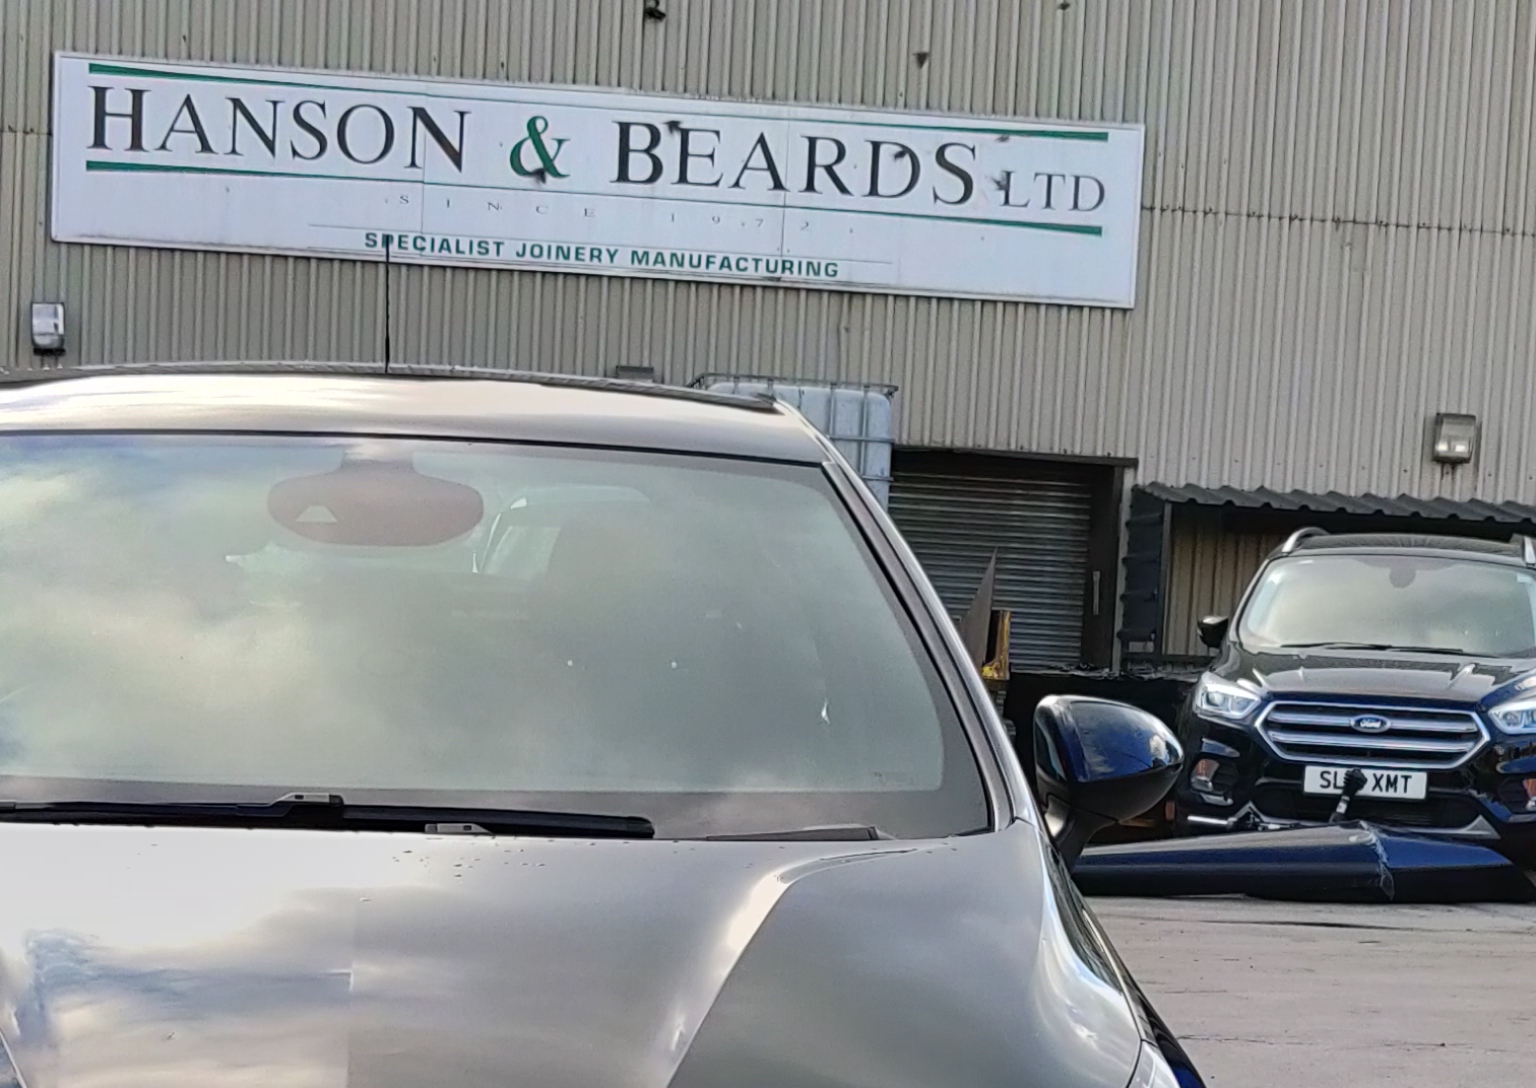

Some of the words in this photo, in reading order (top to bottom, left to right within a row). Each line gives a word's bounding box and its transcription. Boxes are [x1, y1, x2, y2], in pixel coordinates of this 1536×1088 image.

[85, 85, 472, 173] HANSON
[509, 115, 571, 179] &
[608, 120, 977, 206] BEARDS
[1000, 169, 1105, 212] LTD
[365, 232, 505, 257] SPECIALIST
[516, 242, 619, 264] JOINERY
[630, 250, 839, 278] MANUFACTURING
[1372, 772, 1412, 794] XMT
